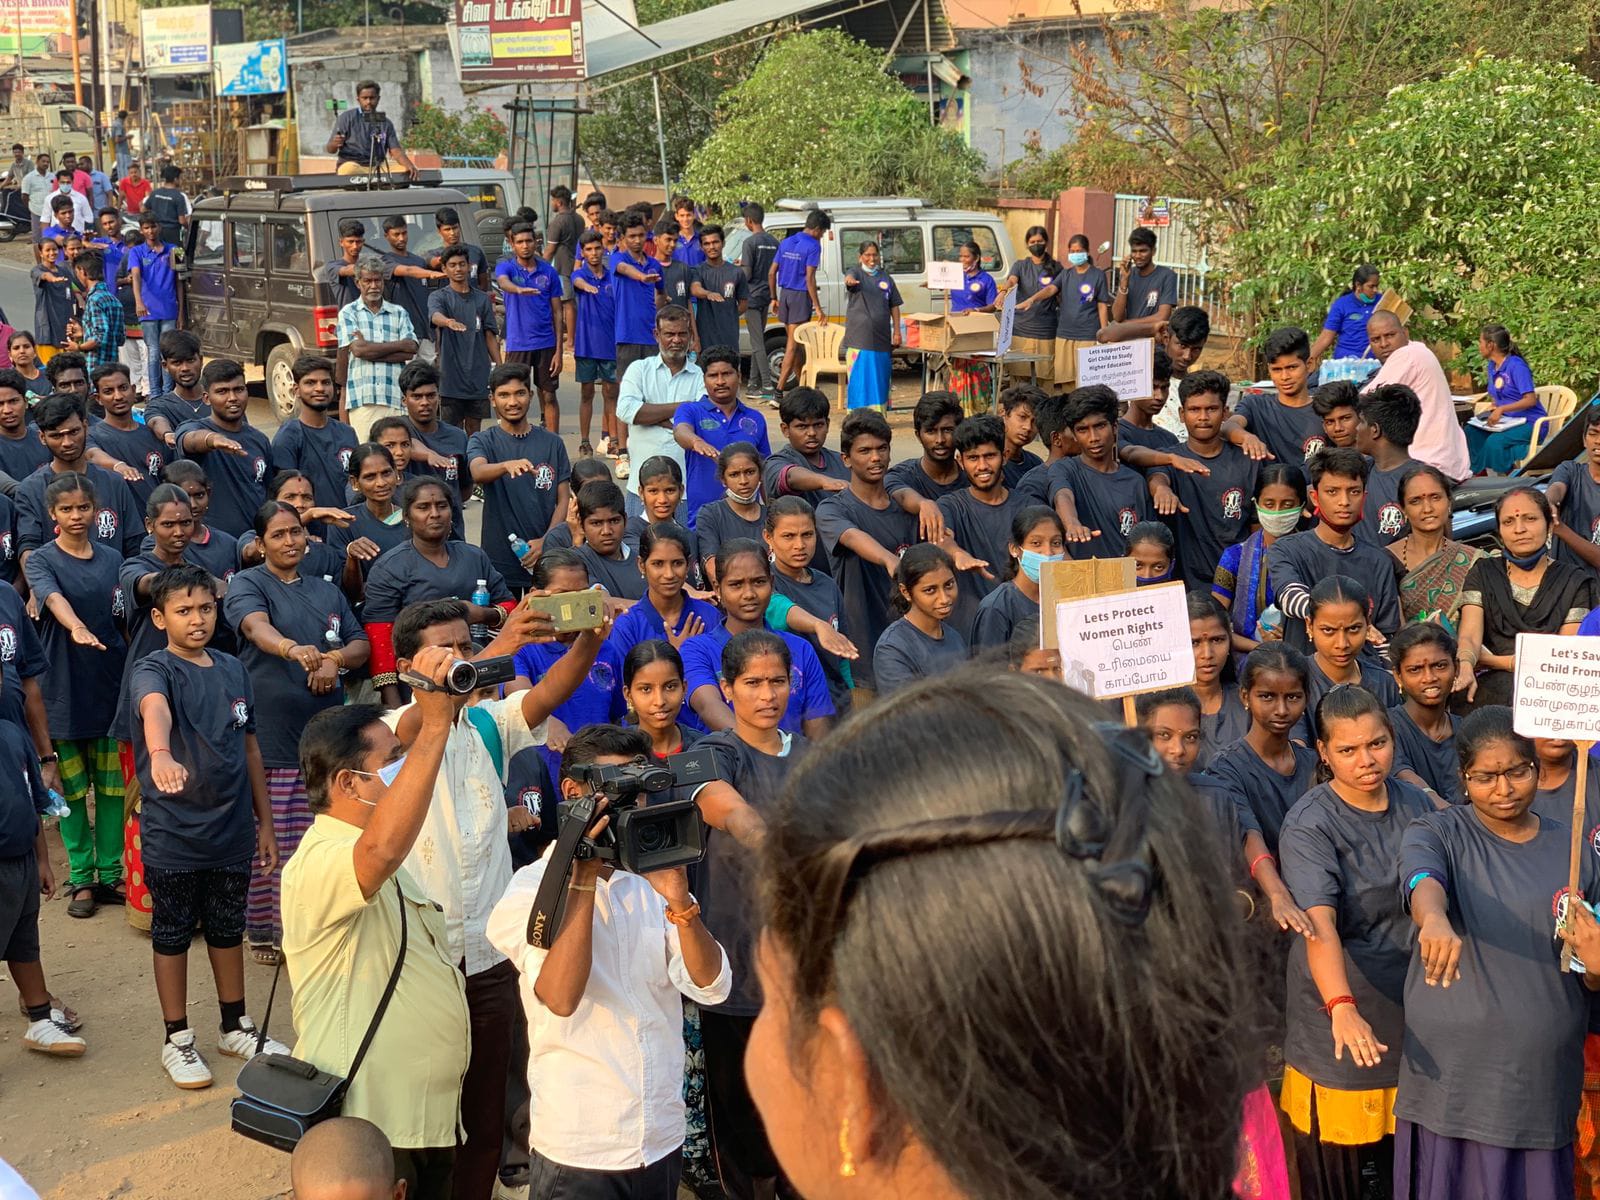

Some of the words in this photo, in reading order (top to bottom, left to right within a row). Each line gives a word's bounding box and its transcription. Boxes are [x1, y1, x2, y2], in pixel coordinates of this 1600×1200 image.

[1107, 361, 1132, 369] Education
[1084, 612, 1109, 624] Lets
[1112, 605, 1155, 619] Protect
[1079, 627, 1124, 641] Women
[1127, 621, 1164, 635] Rights
[1112, 635, 1152, 651] பெண்
[1098, 652, 1172, 672] உரிமையை
[1551, 648, 1579, 659] Let's
[1104, 668, 1167, 689] காப்போம்
[1540, 663, 1569, 674] Child
[1572, 666, 1600, 678] From
[685, 760, 700, 768] 4K
[532, 910, 546, 947] SONY
